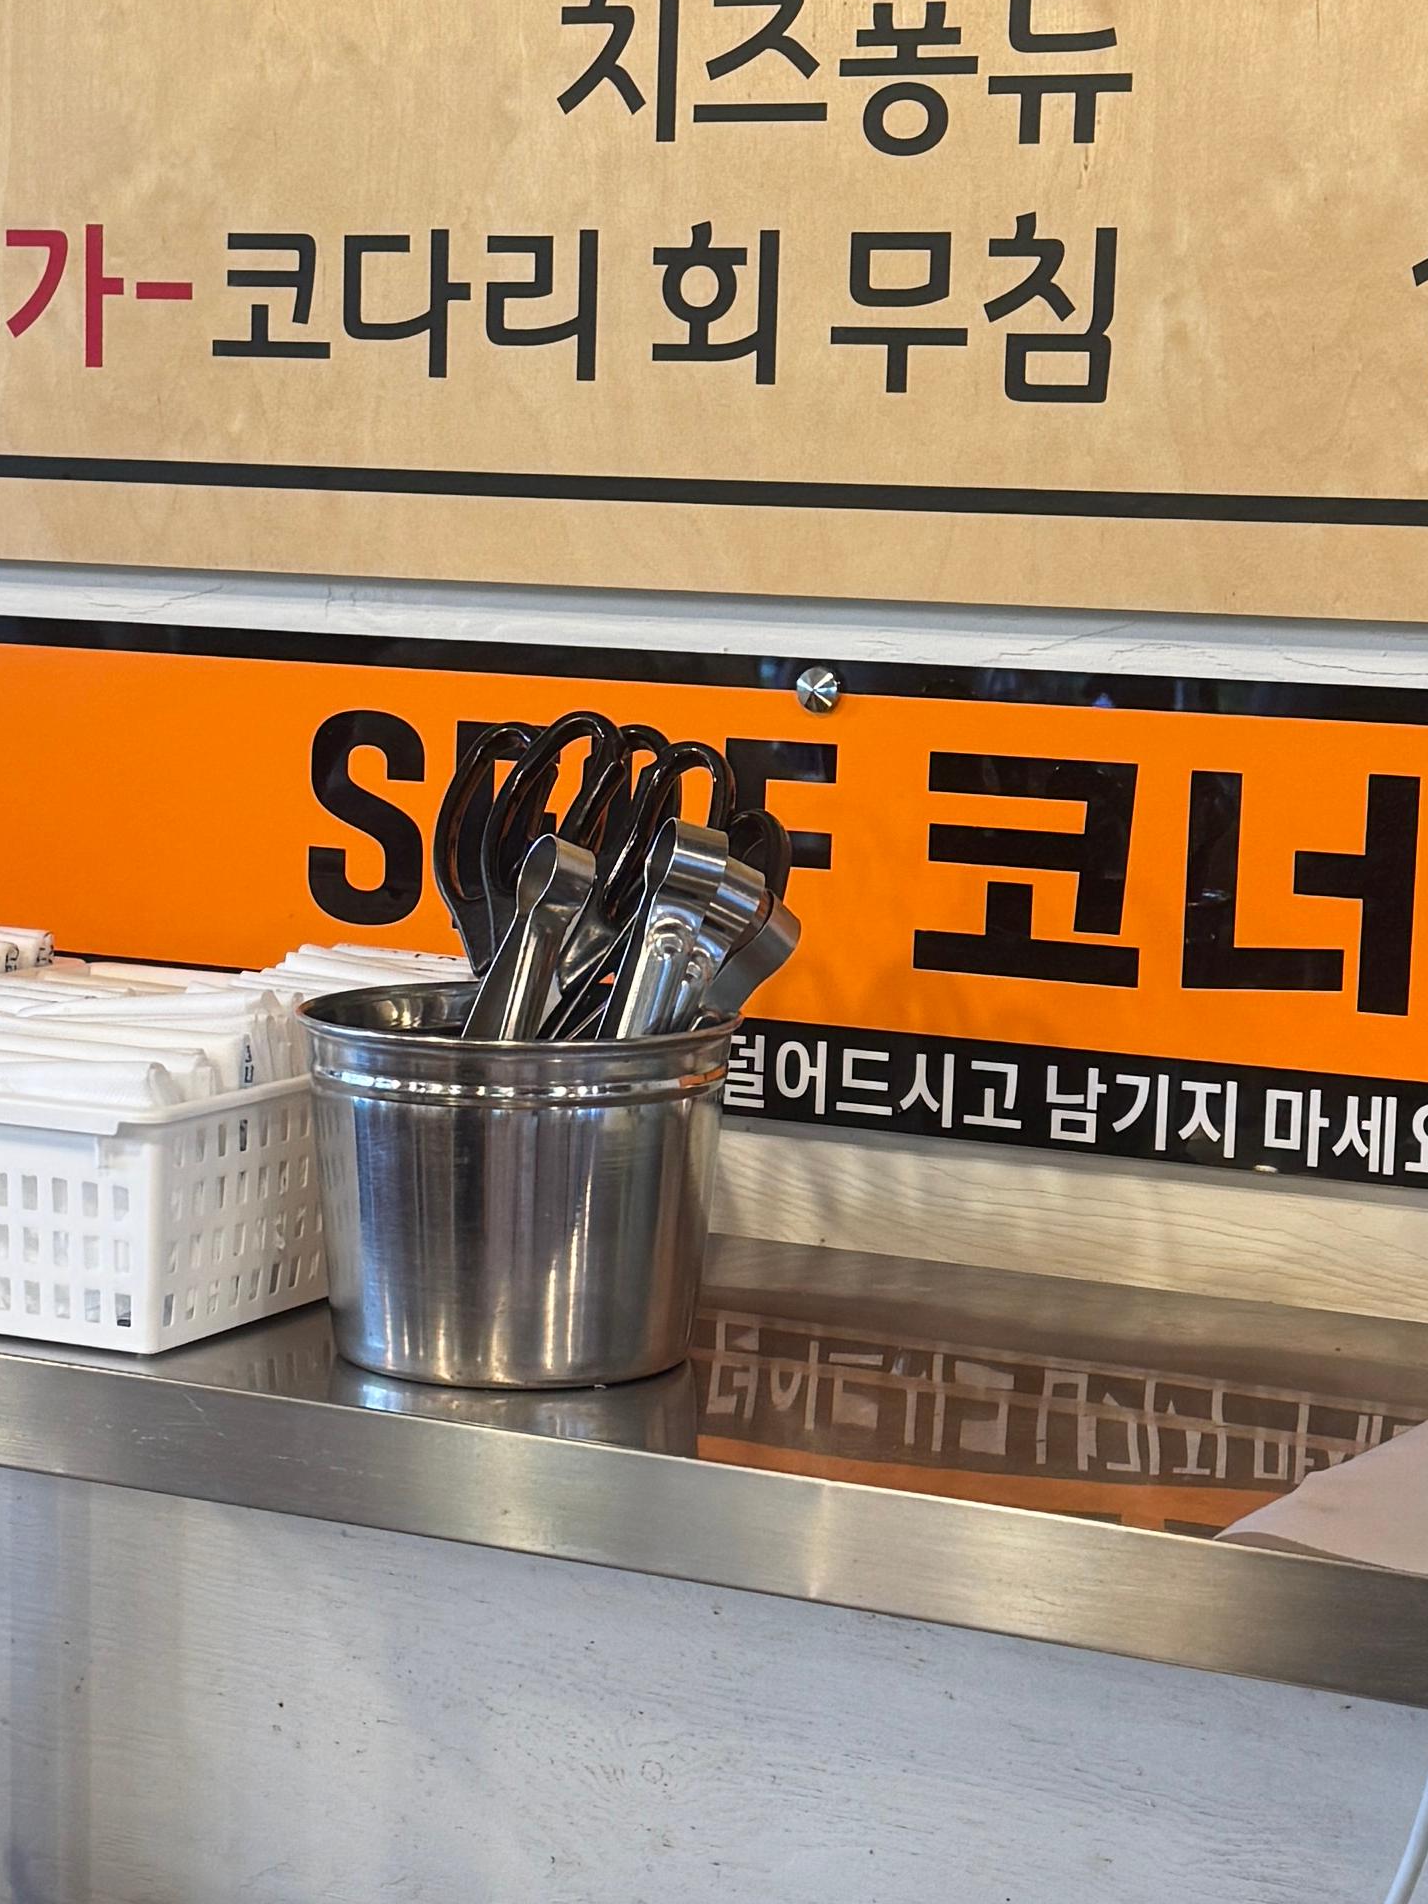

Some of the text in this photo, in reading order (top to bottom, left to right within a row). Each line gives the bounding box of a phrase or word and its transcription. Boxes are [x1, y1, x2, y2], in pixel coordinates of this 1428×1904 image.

[213, 229, 598, 381] 코다리
[652, 221, 779, 384] 회
[831, 212, 1117, 403] 무침
[308, 709, 1420, 1016] SF 코너
[723, 1034, 1022, 1130] 덜어드시고
[1045, 1064, 1238, 1159] 남기지
